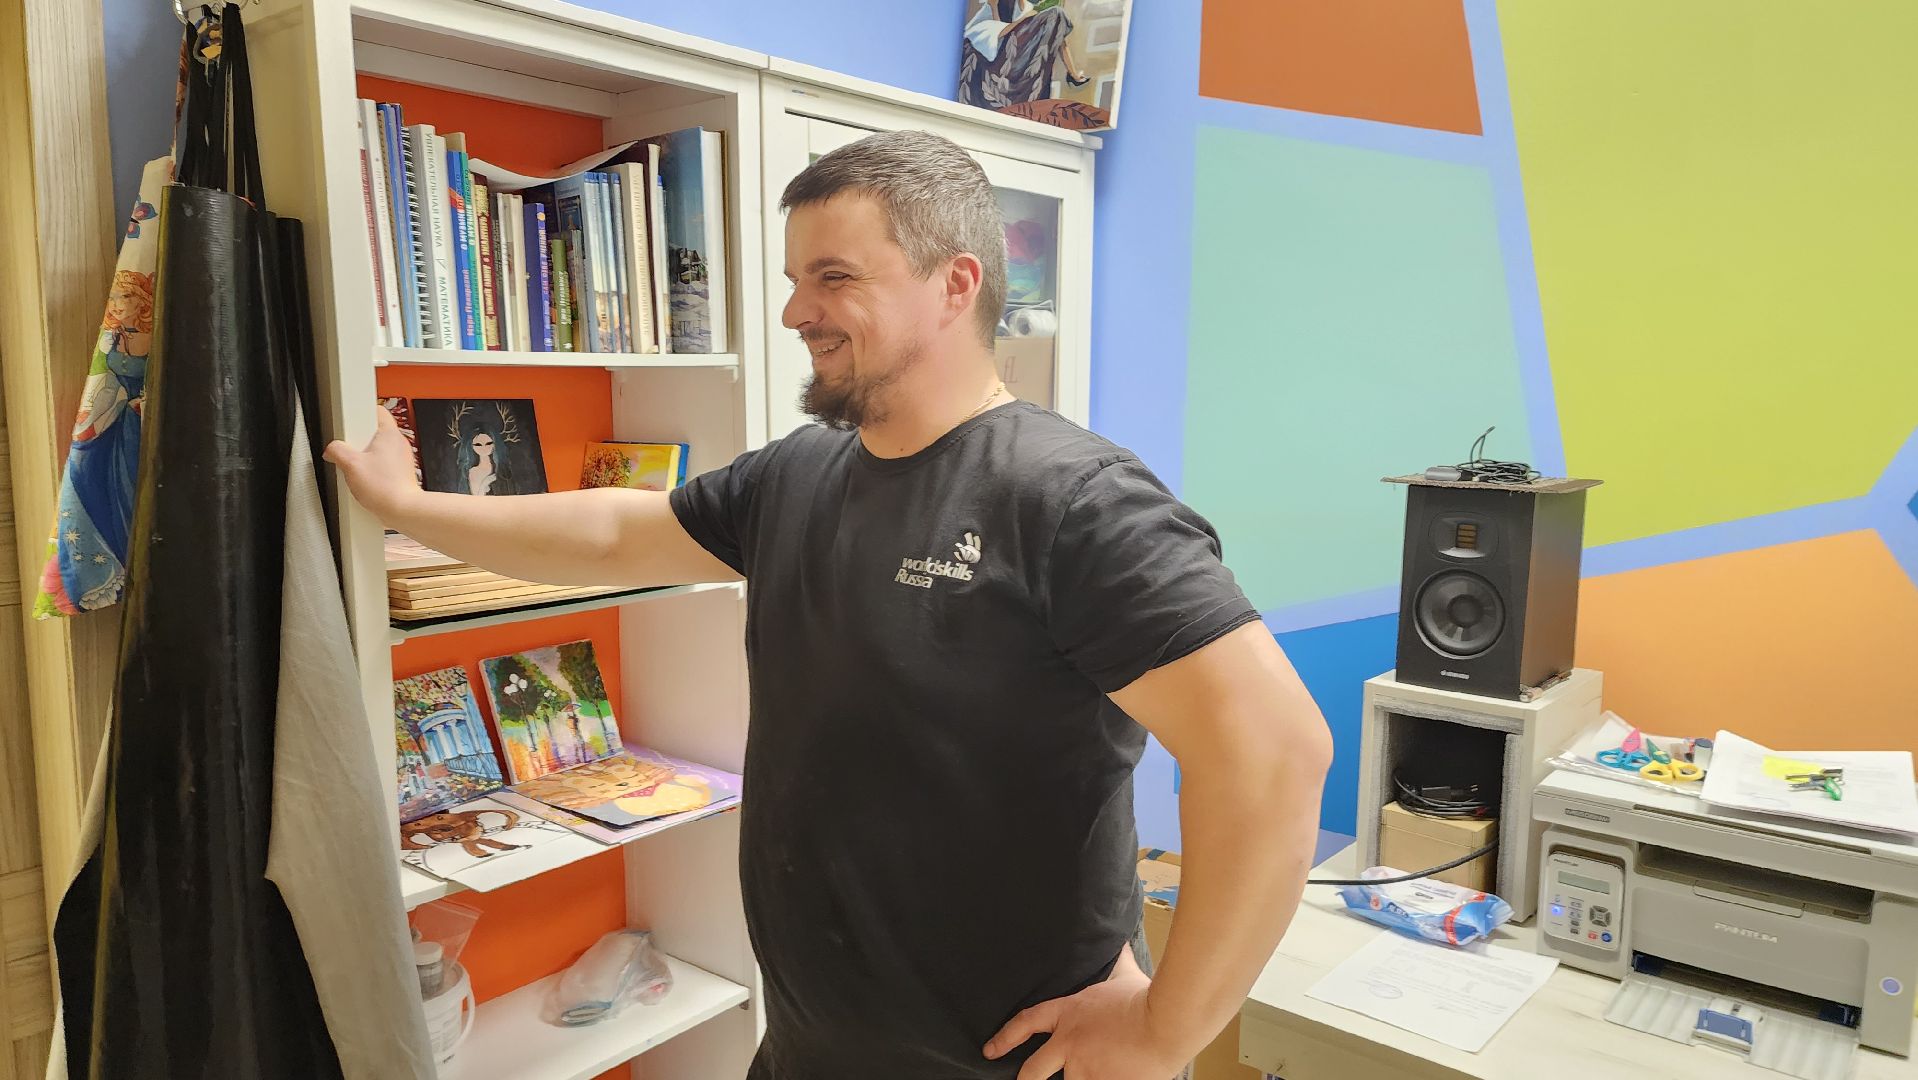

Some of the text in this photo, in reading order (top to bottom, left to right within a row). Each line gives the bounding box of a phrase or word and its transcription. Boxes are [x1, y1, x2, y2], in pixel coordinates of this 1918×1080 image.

[425, 133, 453, 346] УВЛЕКАТЕЛЬНАЯ НАУКА МАТЕМАТИКА
